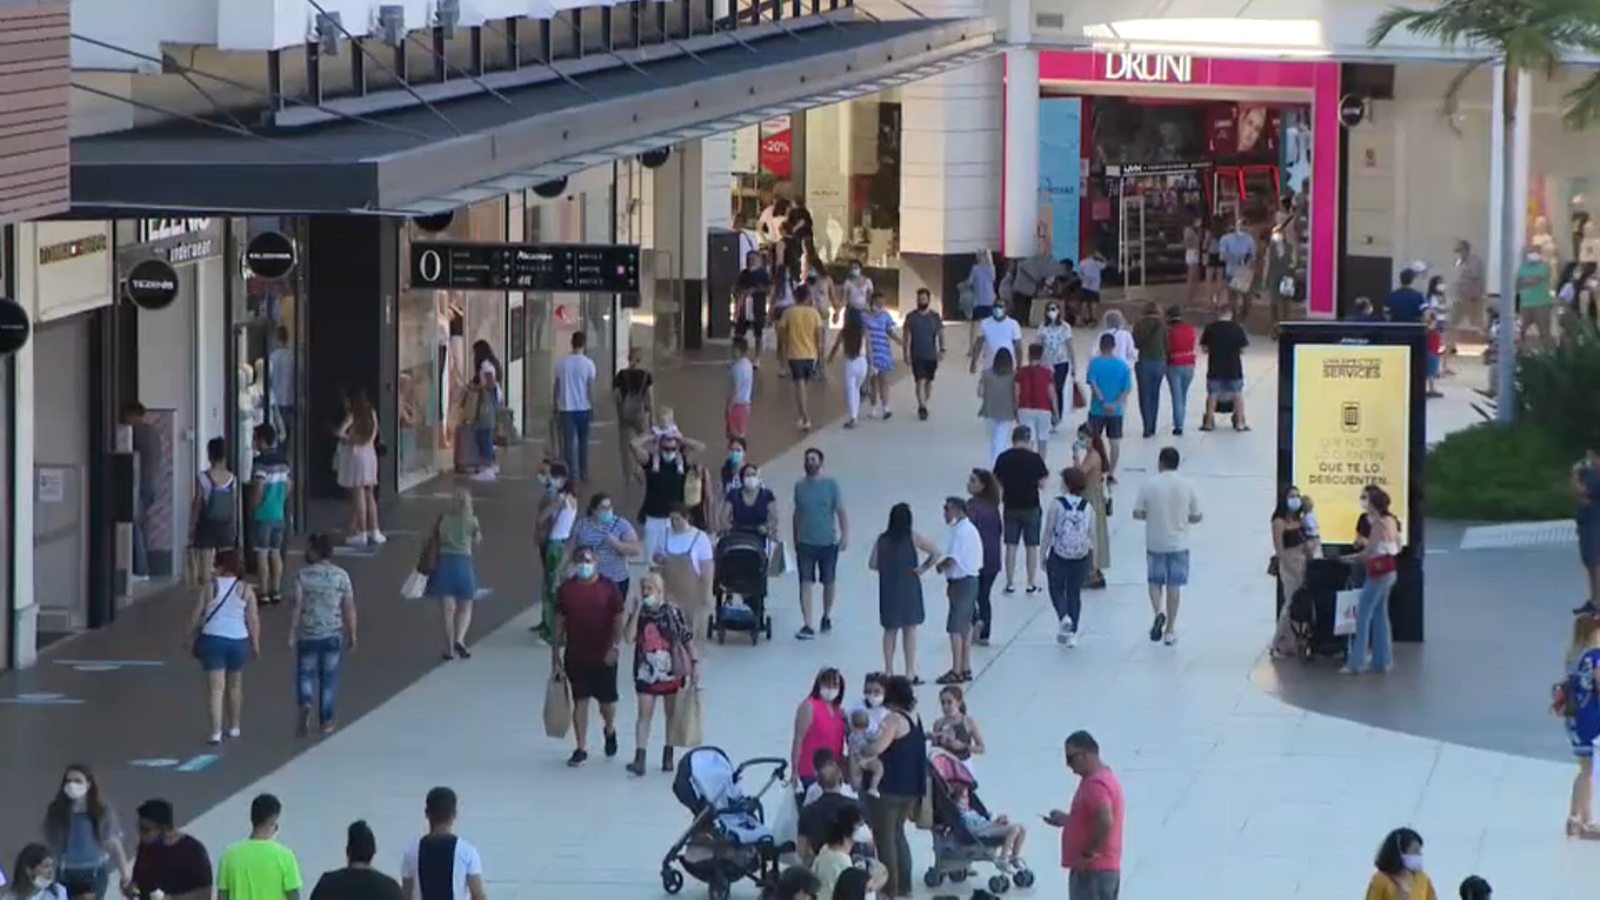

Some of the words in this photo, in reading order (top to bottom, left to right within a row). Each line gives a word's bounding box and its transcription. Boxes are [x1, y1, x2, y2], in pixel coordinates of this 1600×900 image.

[1106, 52, 1192, 82] DRUNI
[762, 140, 789, 153] -20%
[170, 239, 212, 262] underwear
[1322, 364, 1382, 379] SERVICES
[1319, 462, 1343, 473] QUE
[1347, 463, 1360, 473] TE
[1364, 463, 1380, 474] LO
